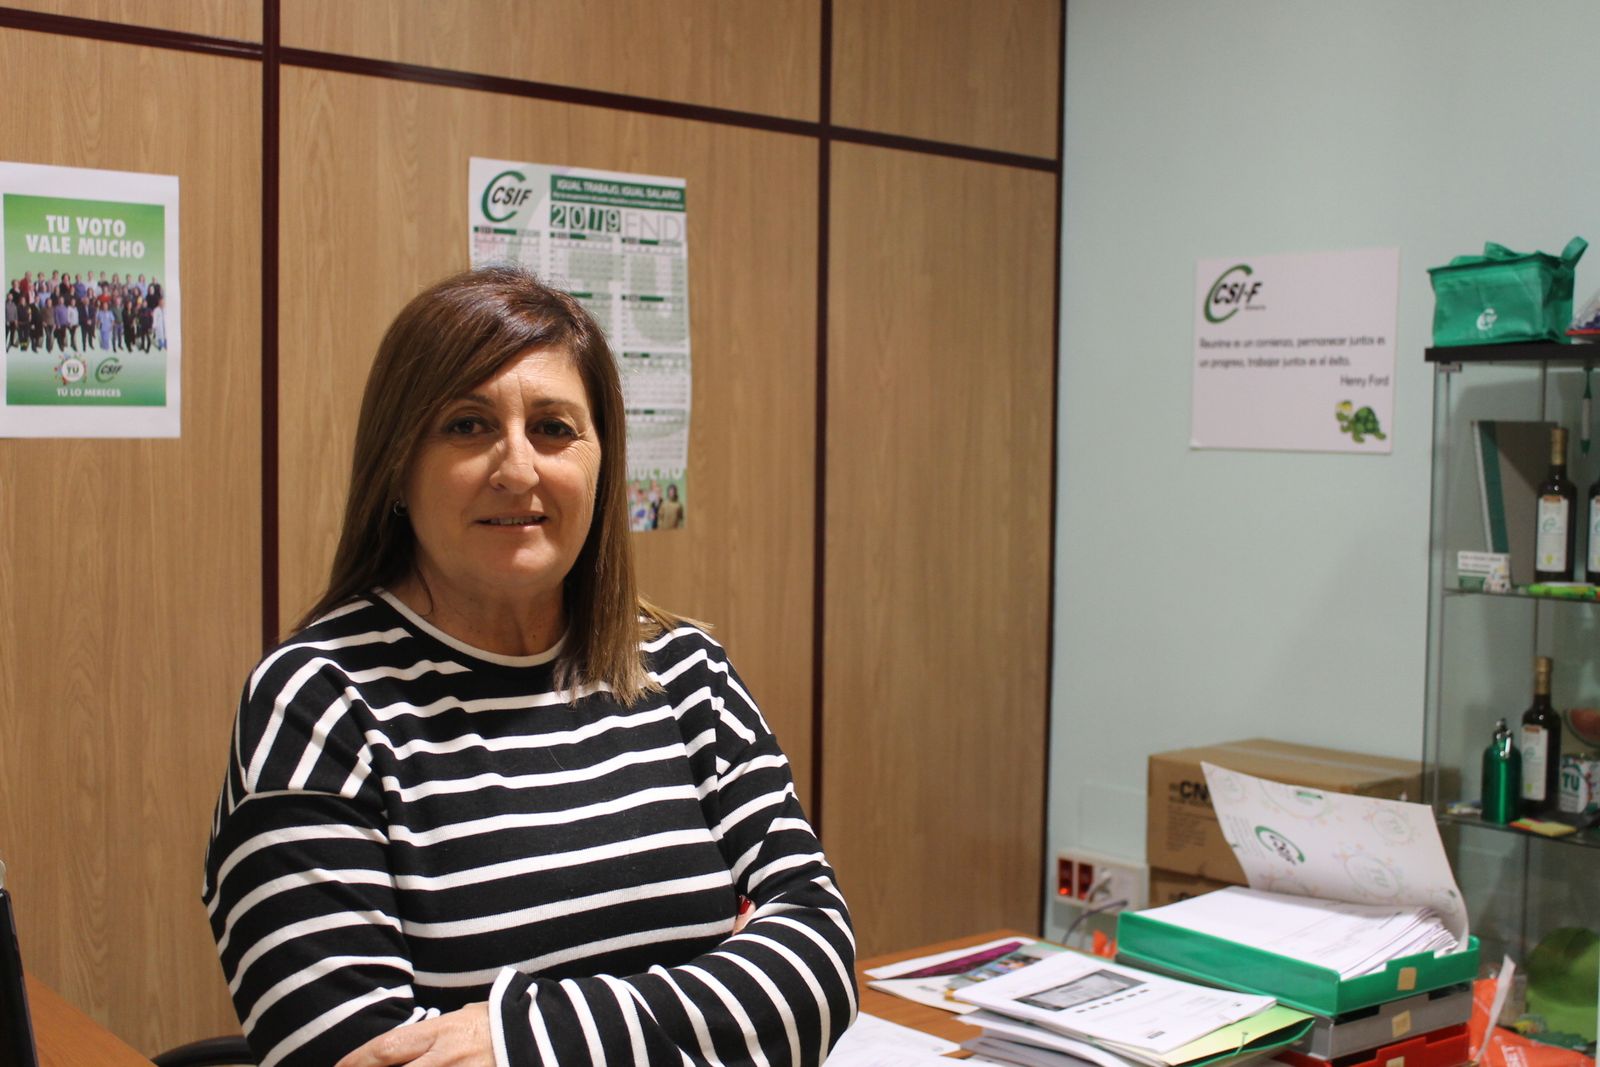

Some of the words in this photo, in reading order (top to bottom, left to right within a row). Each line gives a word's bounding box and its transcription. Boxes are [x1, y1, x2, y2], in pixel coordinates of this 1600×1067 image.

[491, 185, 532, 207] CSIF
[556, 178, 582, 192] IGUAL
[621, 185, 644, 198] IGUAL
[645, 186, 682, 201] SALARIO
[46, 215, 70, 233] TU
[76, 217, 126, 237] VOTO
[550, 204, 621, 233] 2019
[26, 234, 71, 254] VALE
[78, 237, 145, 258] MUCHO
[1213, 281, 1263, 304] CSI-F
[1296, 336, 1347, 349] permanecer
[1348, 334, 1375, 348] juntos
[1339, 374, 1366, 389] Henry
[1368, 373, 1390, 387] Ford
[70, 388, 82, 397] LO
